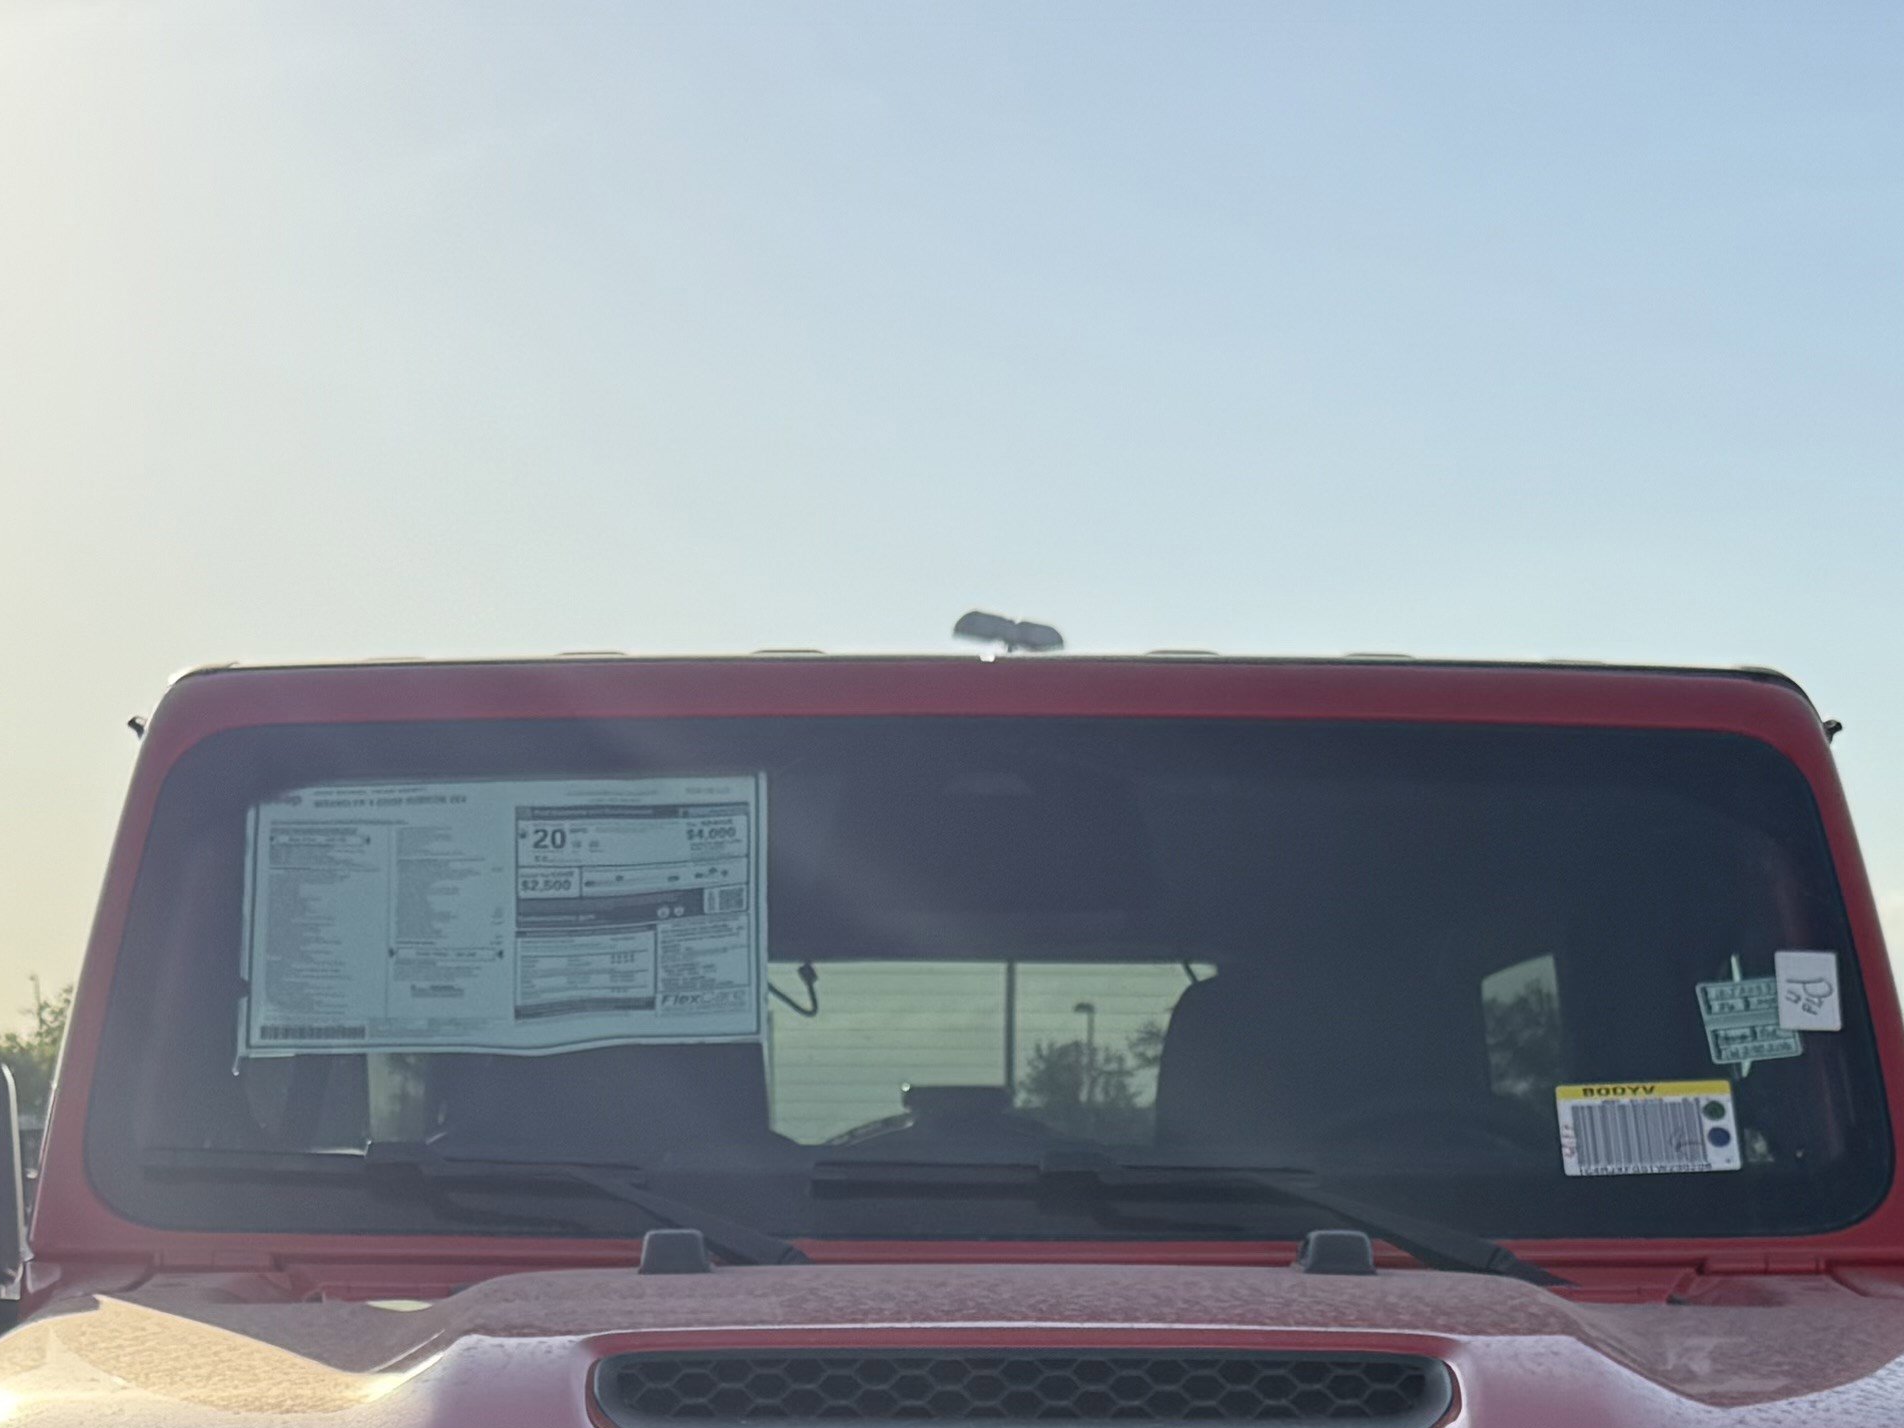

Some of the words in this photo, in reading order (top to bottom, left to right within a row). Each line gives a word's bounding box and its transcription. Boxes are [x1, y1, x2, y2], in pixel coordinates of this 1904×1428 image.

[532, 828, 567, 849] 20
[520, 878, 573, 892] $2,500
[1582, 1085, 1656, 1098] BODYV
